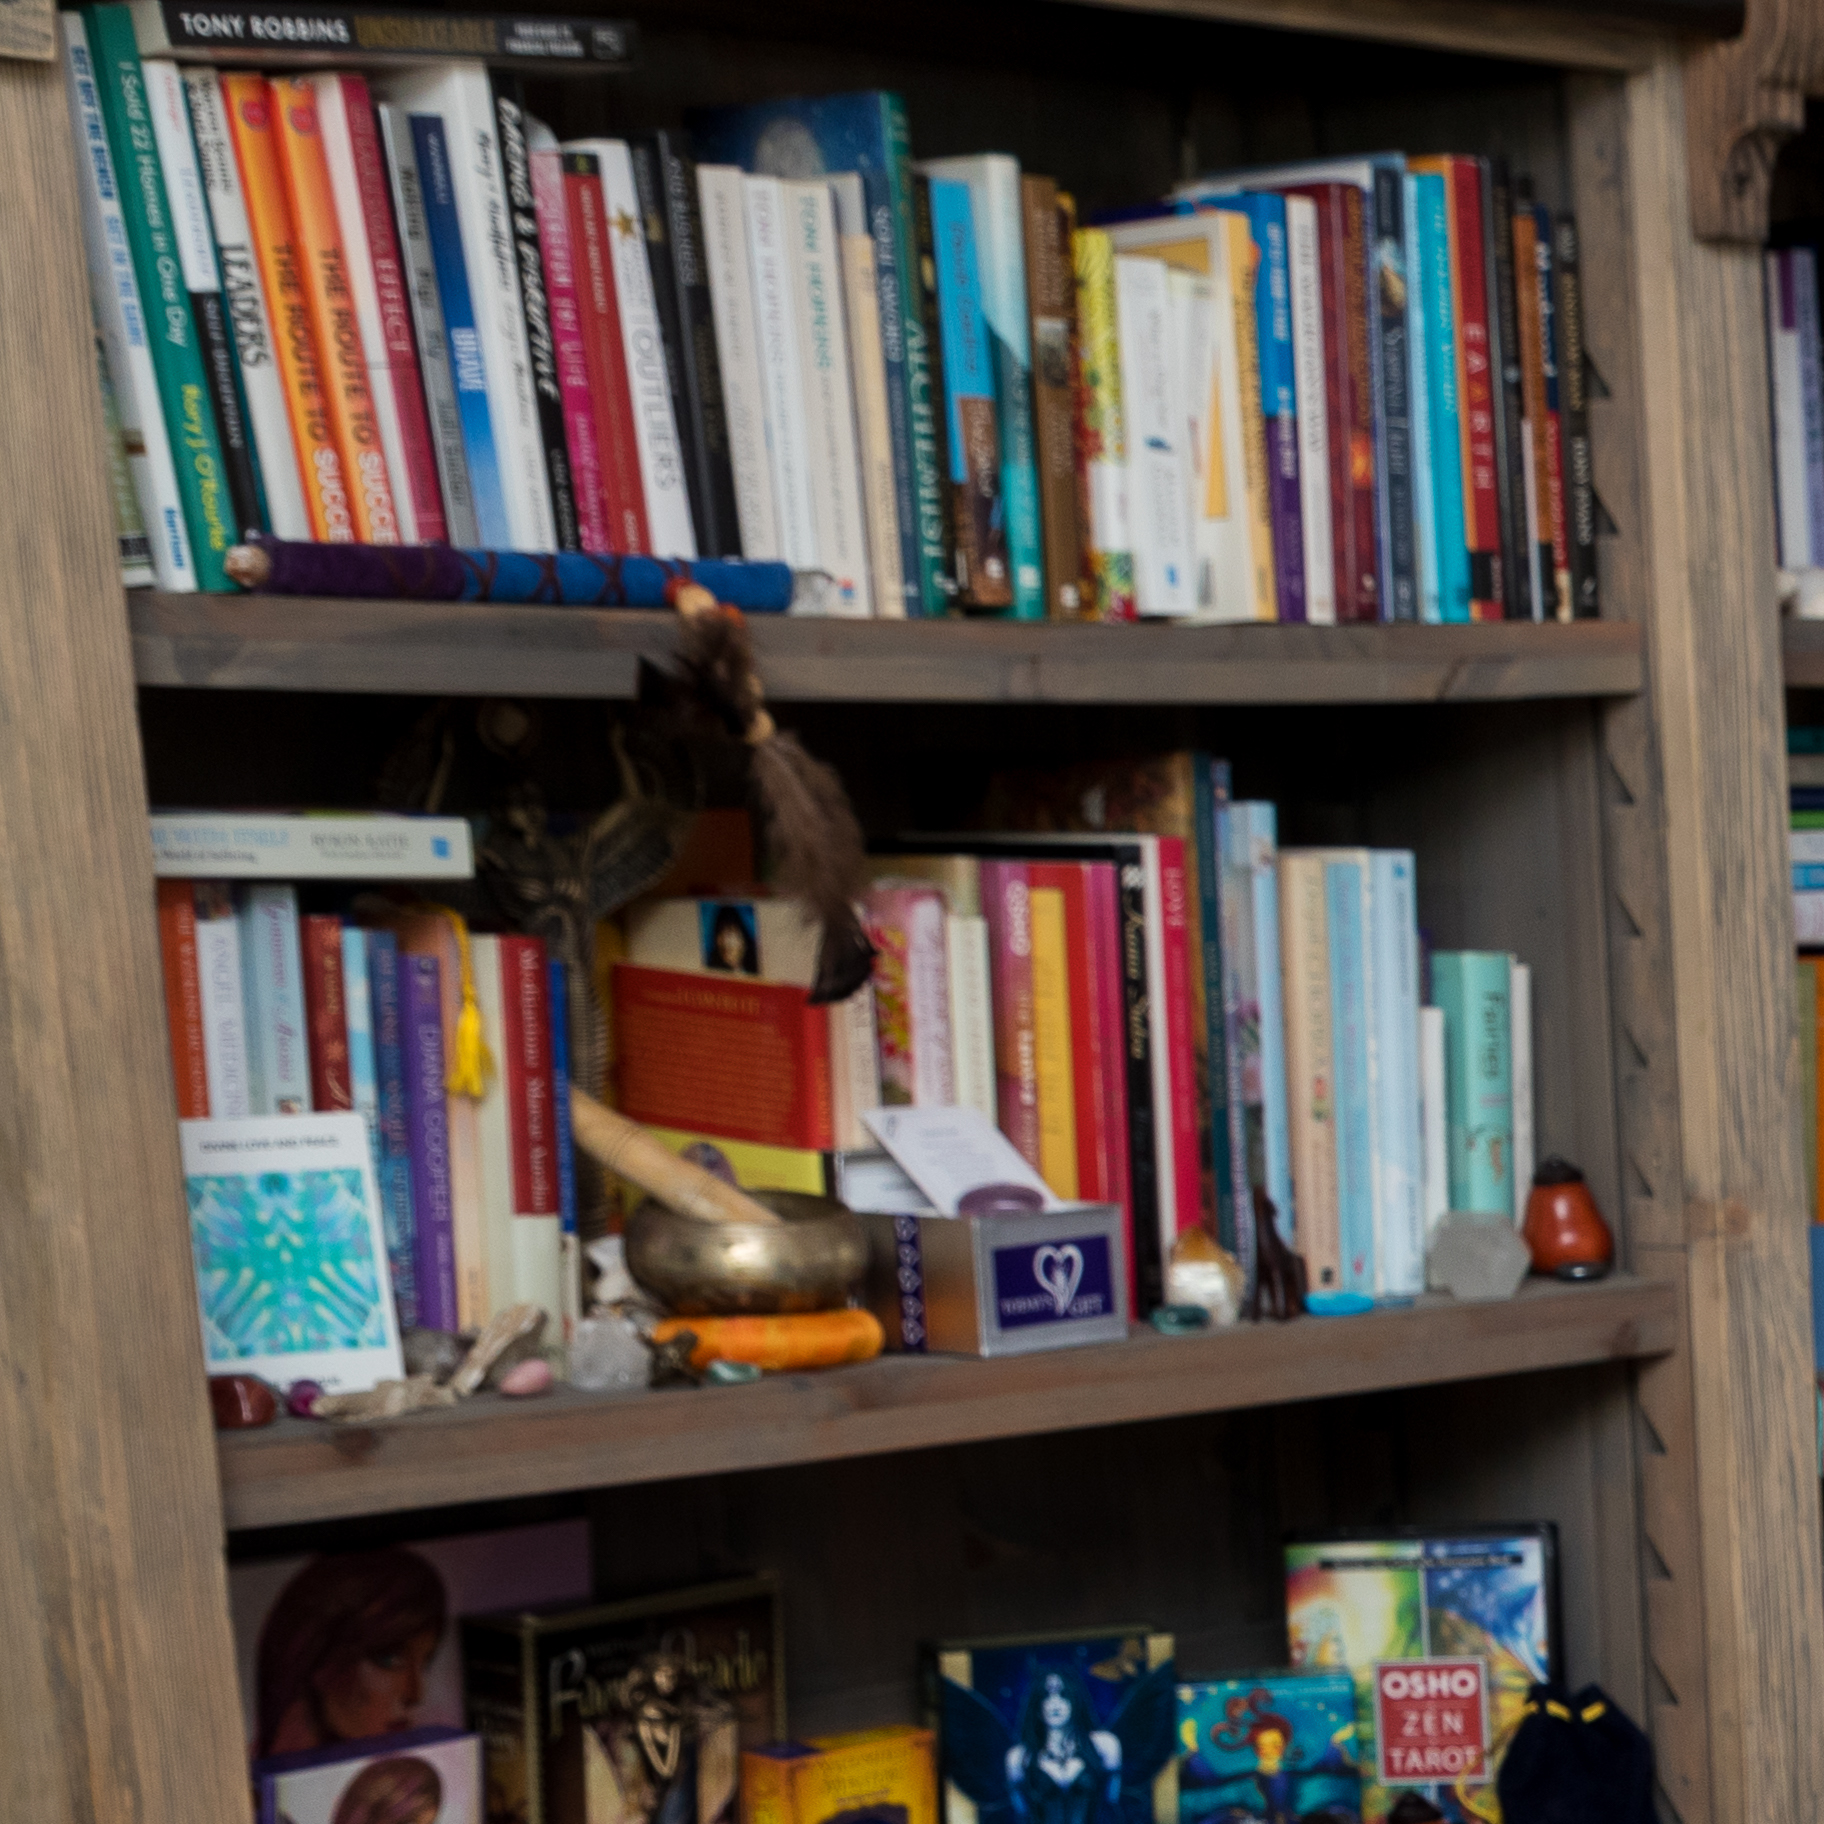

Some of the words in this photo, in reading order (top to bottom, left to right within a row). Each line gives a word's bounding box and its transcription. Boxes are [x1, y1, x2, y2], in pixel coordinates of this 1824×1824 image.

[179, 12, 247, 39] TONY
[250, 15, 350, 43] ROBBINS
[117, 59, 137, 70] I
[119, 72, 146, 117] Sold
[129, 120, 152, 149] 22
[496, 99, 534, 209] DARING
[136, 153, 168, 228] Homes
[151, 230, 172, 252] in
[512, 211, 537, 235] &
[154, 253, 181, 302] One
[272, 242, 299, 294] THE
[317, 247, 344, 298] THE
[159, 303, 190, 349] Day
[217, 239, 273, 371] LEADERS
[516, 236, 563, 403] DISRUPTIVE
[284, 302, 318, 396] ROUTE
[330, 308, 364, 396] ROUTE
[174, 381, 207, 434] Rory
[302, 409, 328, 442] TO
[348, 408, 374, 443] TO
[629, 324, 679, 493] OUTLIERS
[185, 434, 211, 448] J
[903, 317, 946, 560] ALCHEMIST
[190, 450, 231, 551] O'Rourke
[313, 447, 353, 543] SUCCE
[357, 449, 396, 543] SUCCE
[417, 1021, 444, 1104] DIANA
[422, 1107, 451, 1222] COOPER
[1381, 1668, 1480, 1700] OSHO
[1401, 1709, 1465, 1737] ZEN
[1390, 1744, 1485, 1774] TAROT
